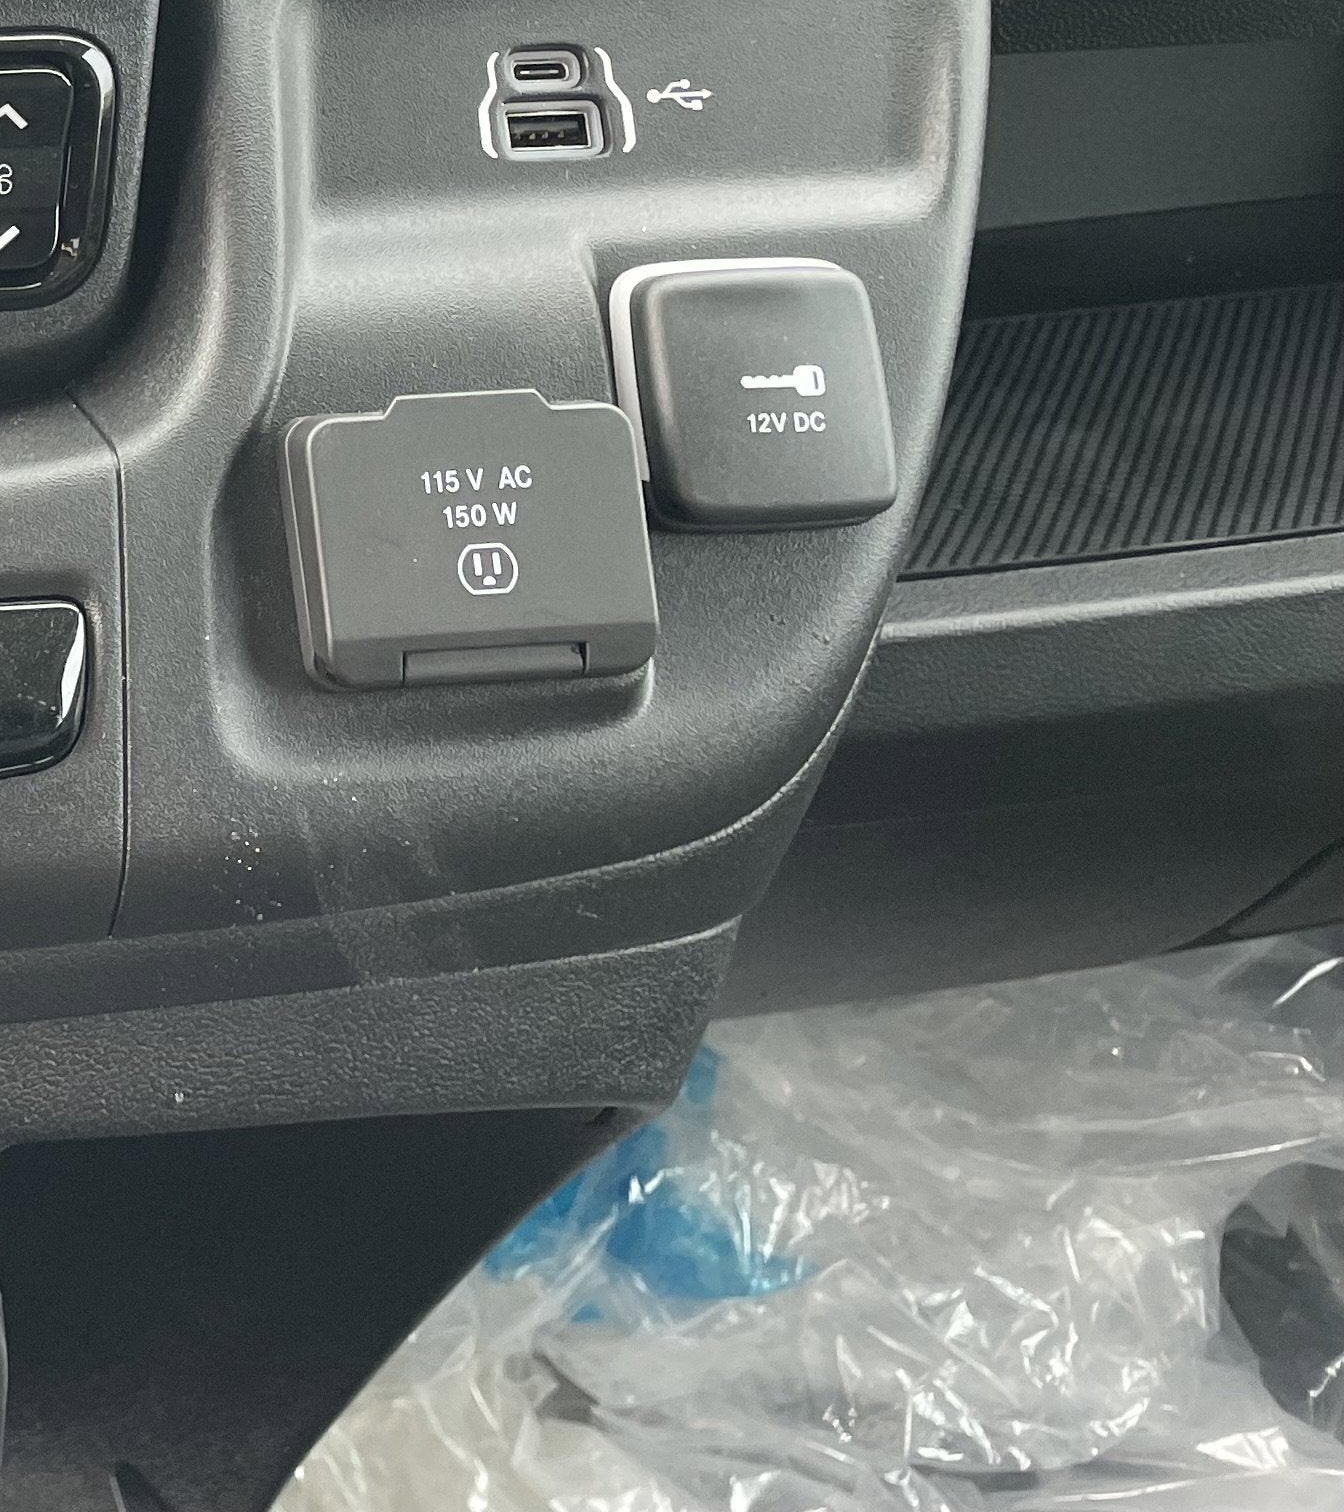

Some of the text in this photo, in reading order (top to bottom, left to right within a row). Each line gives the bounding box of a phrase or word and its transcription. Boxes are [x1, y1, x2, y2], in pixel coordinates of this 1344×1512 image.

[746, 411, 827, 434] 12V DC
[420, 464, 533, 495] 115 V AC
[442, 501, 518, 529] 150 W
